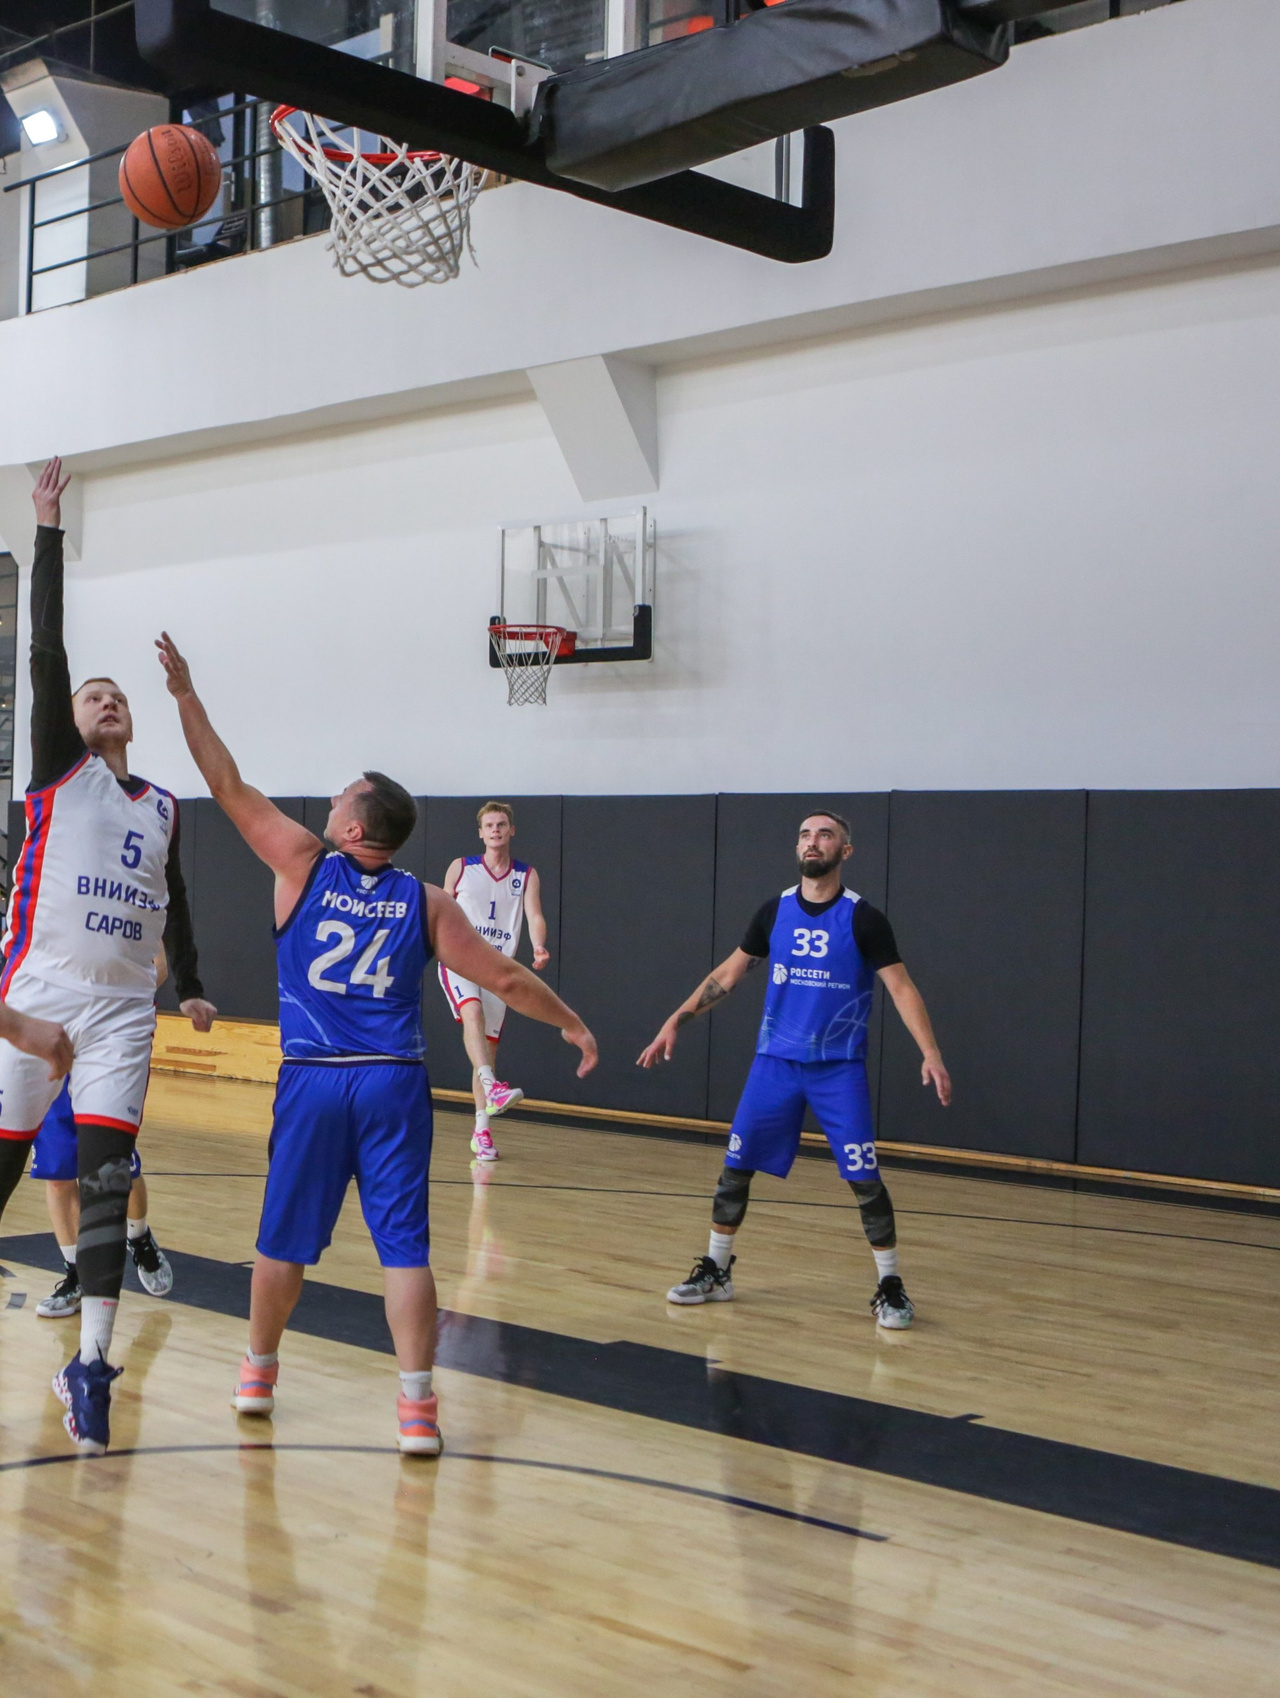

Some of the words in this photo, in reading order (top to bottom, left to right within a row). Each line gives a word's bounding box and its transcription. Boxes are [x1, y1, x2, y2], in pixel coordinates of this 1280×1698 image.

[120, 829, 145, 869] 5
[321, 890, 407, 919] МОИСЕЕВ
[488, 901, 496, 920] 1
[85, 911, 143, 941] САРОВ
[475, 925, 512, 941] НИИЭФ
[791, 927, 830, 958] 33
[307, 920, 395, 998] 24
[790, 967, 830, 980] РОССЕТИ
[454, 985, 464, 999] 1
[843, 1142, 878, 1171] 33
